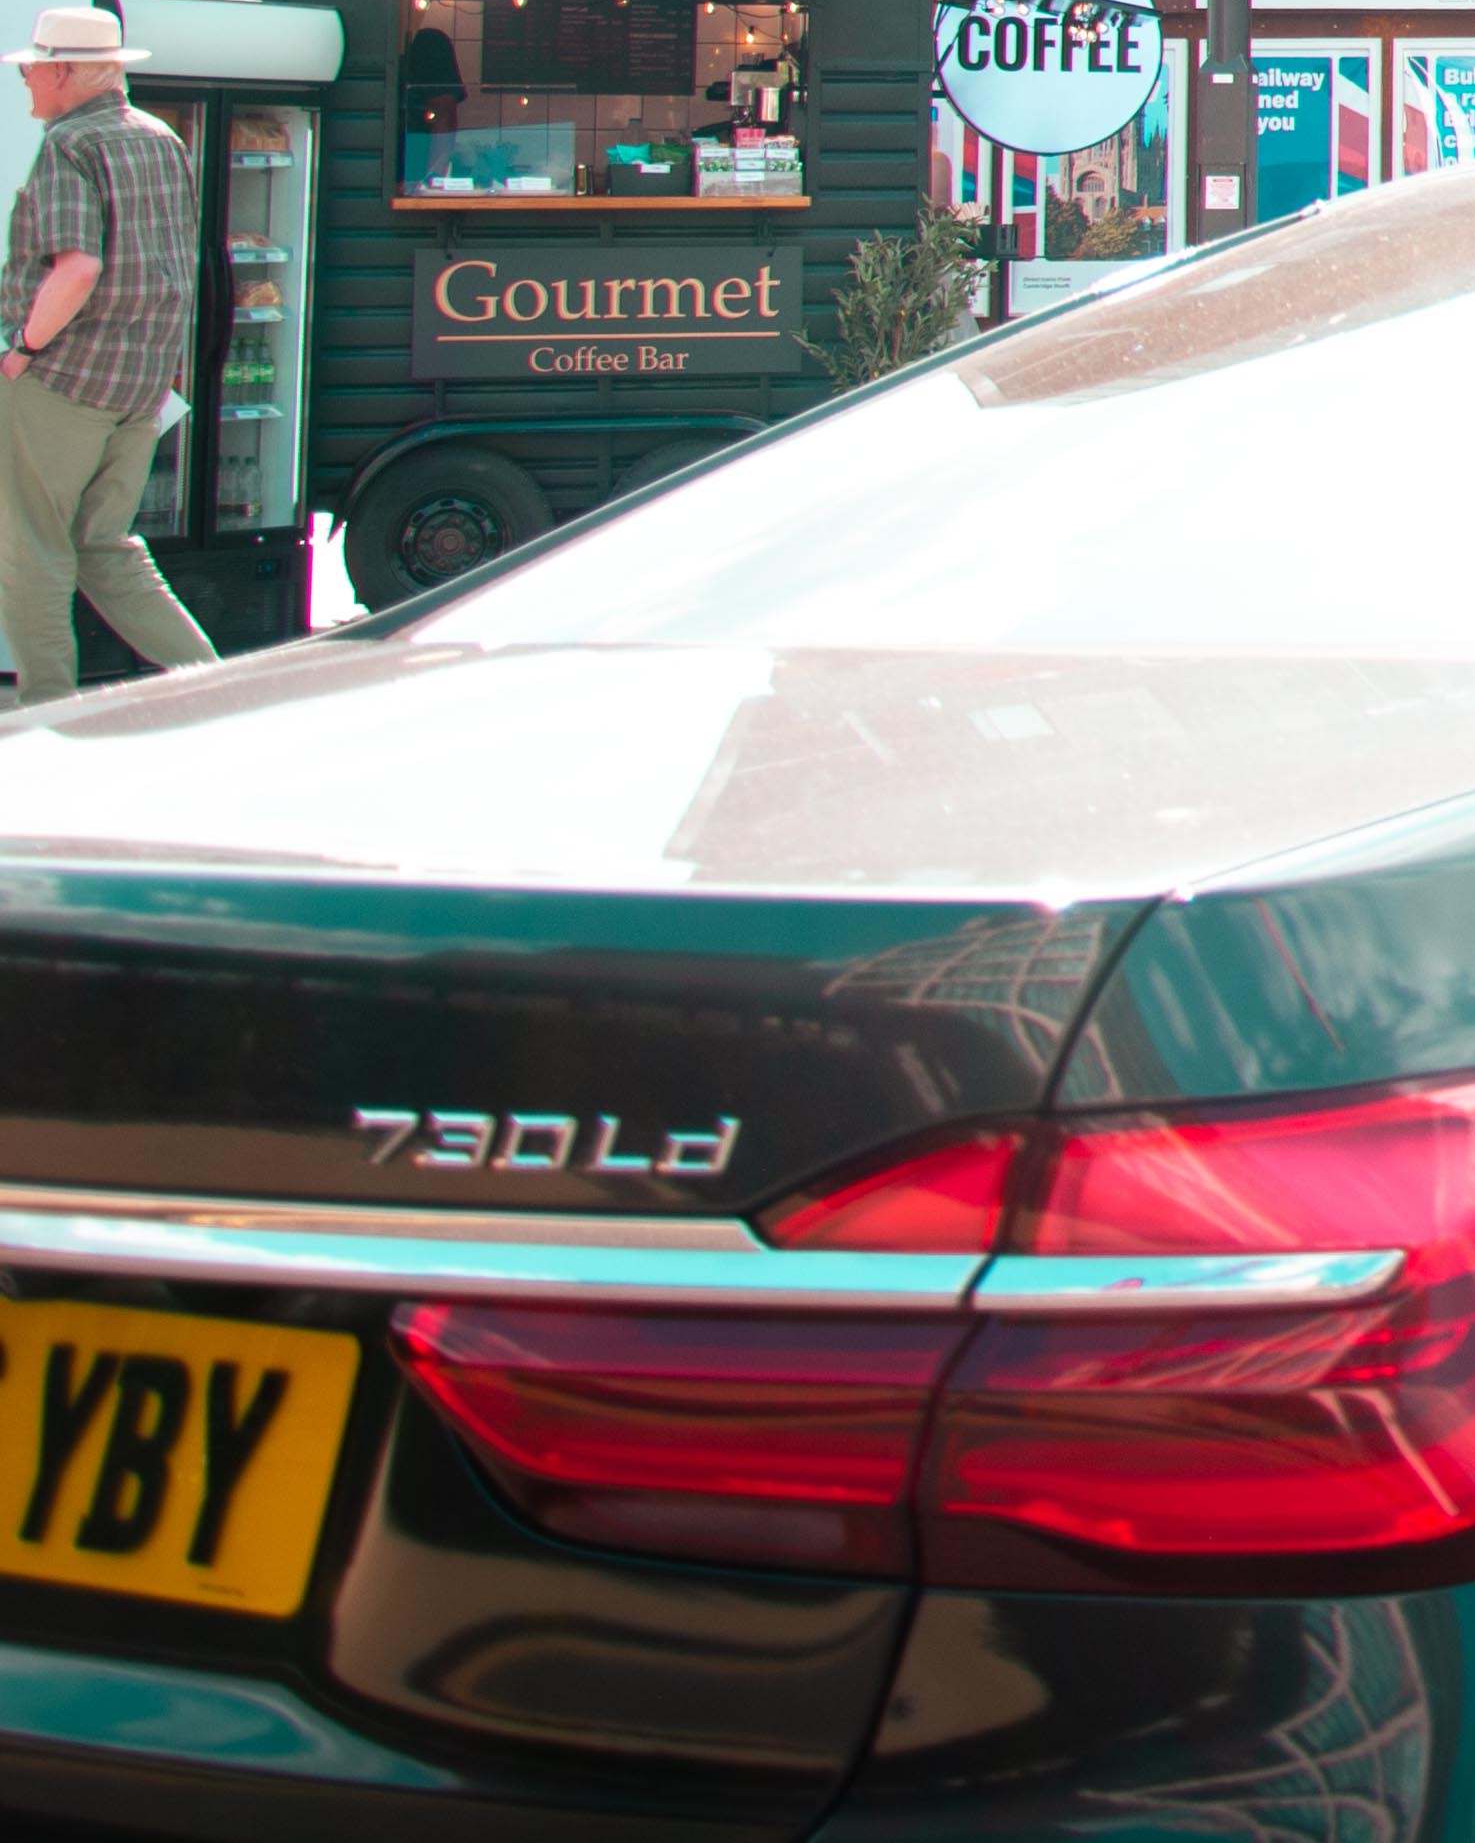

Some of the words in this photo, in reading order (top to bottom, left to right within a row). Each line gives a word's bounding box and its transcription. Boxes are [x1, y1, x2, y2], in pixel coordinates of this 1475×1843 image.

[957, 12, 1142, 73] COFFEE
[1256, 115, 1295, 136] you
[434, 260, 781, 323] Gourmet
[529, 346, 629, 373] Coffee
[637, 346, 690, 372] Bar
[355, 1107, 741, 1175] 730Ld
[18, 1342, 291, 1567] YBY
